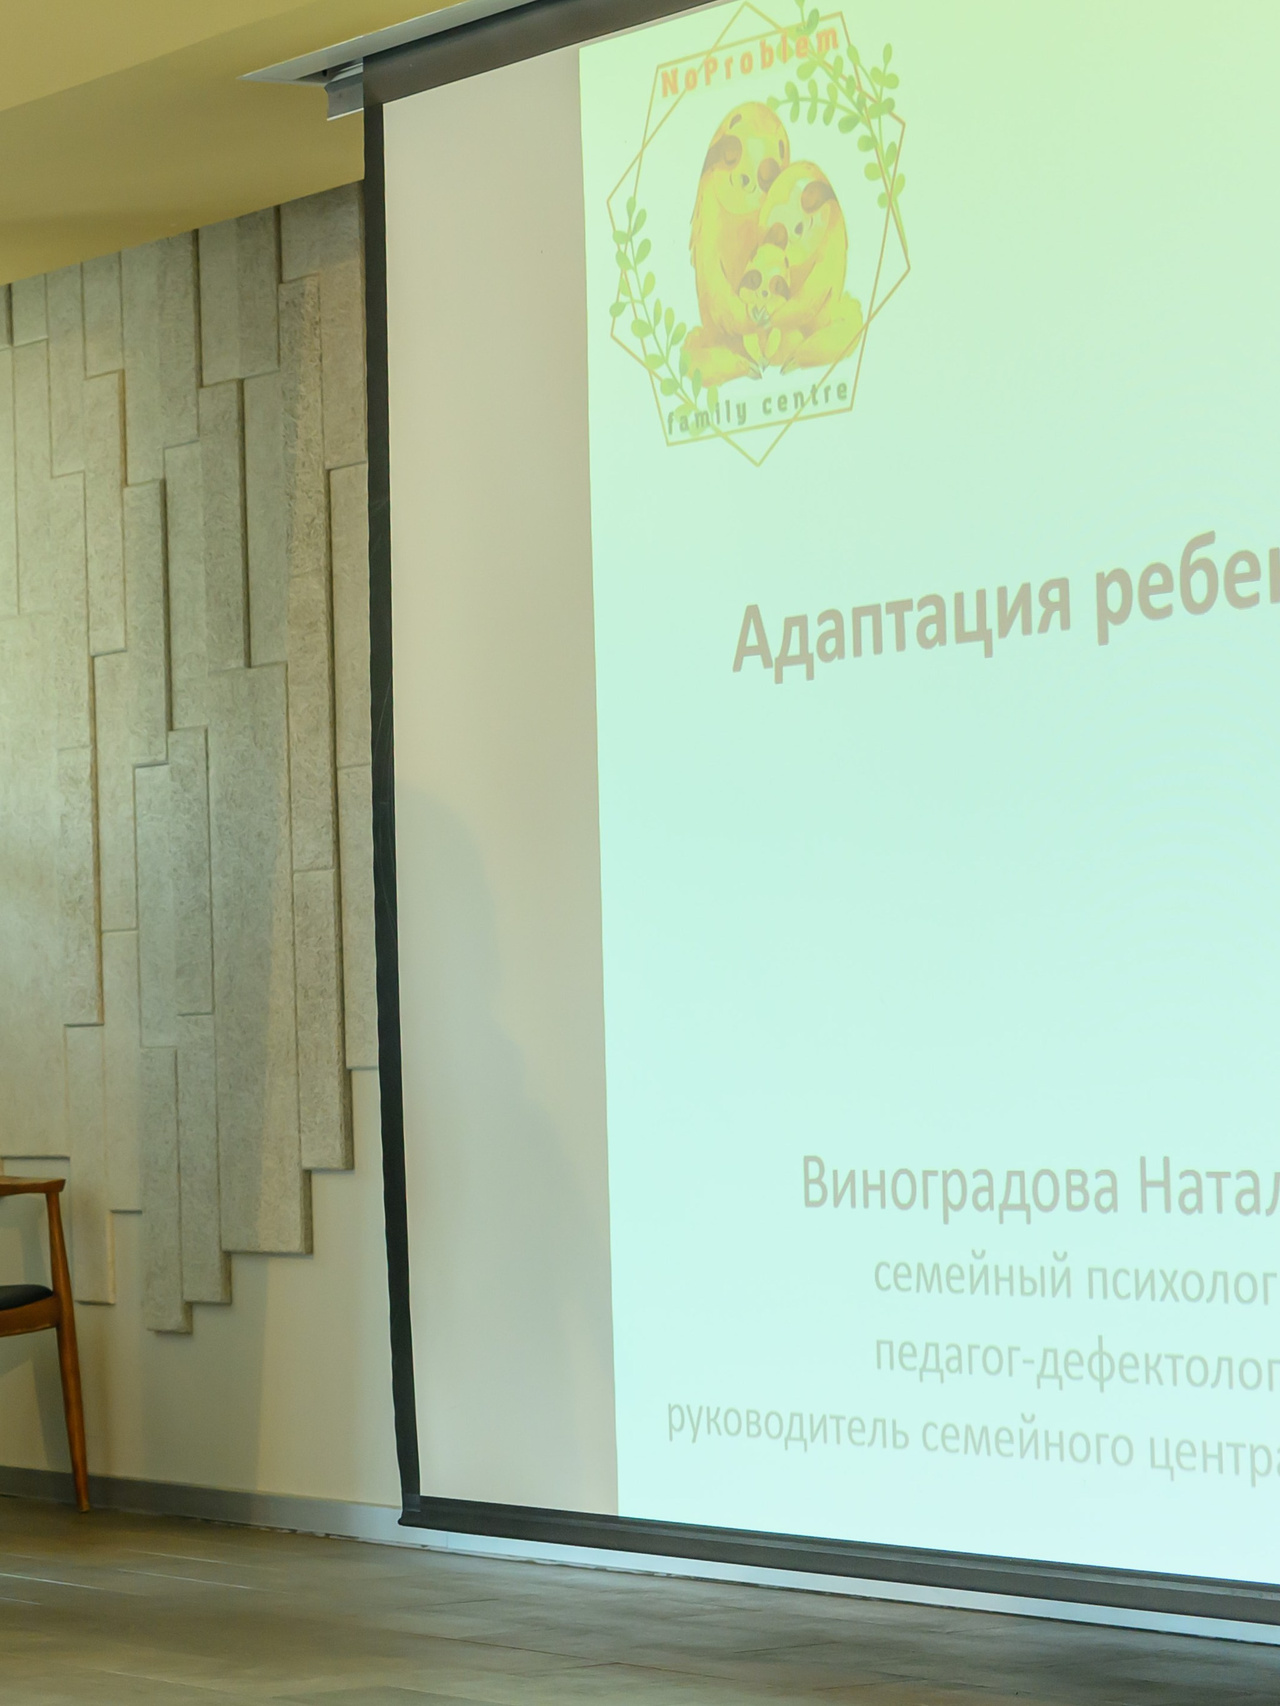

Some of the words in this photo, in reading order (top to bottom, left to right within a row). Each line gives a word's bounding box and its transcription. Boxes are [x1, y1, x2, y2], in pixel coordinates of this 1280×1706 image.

[661, 27, 838, 98] NoProblem
[667, 399, 747, 435] family
[762, 382, 847, 416] centre
[732, 576, 1072, 685] Адаптация
[802, 1154, 1120, 1225] Виноградова
[873, 1248, 1073, 1299] семейный
[1086, 1264, 1277, 1306] психолог
[875, 1335, 1280, 1393] педагог-дефектолог
[667, 1401, 910, 1453] руководитель
[920, 1412, 1135, 1467] семейного
[1148, 1435, 1280, 1488] центр
